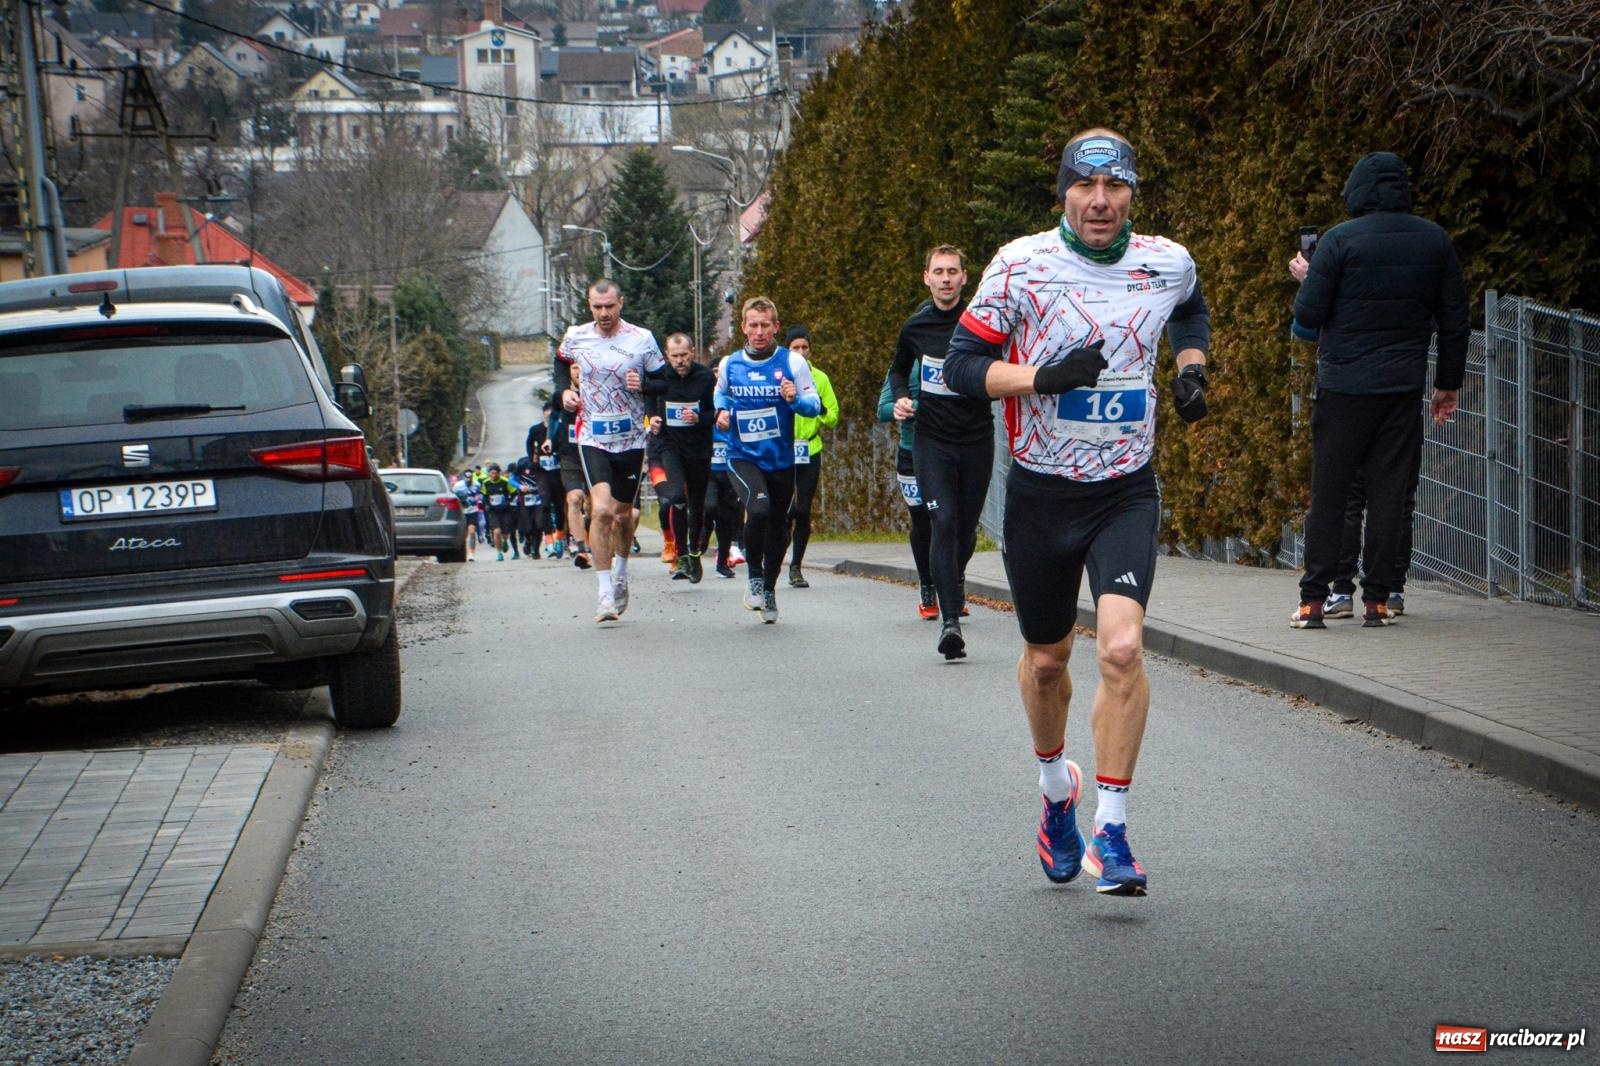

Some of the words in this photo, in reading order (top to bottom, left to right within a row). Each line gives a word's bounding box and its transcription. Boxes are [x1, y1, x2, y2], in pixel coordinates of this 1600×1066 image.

[1076, 148, 1118, 160] ELIMINATOR
[1086, 392, 1124, 421] 16
[603, 421, 620, 434] 15
[747, 418, 766, 433] 60
[903, 484, 919, 497] 49
[79, 489, 113, 513] OP
[127, 483, 207, 511] 1239P
[109, 537, 182, 550] Ateca
